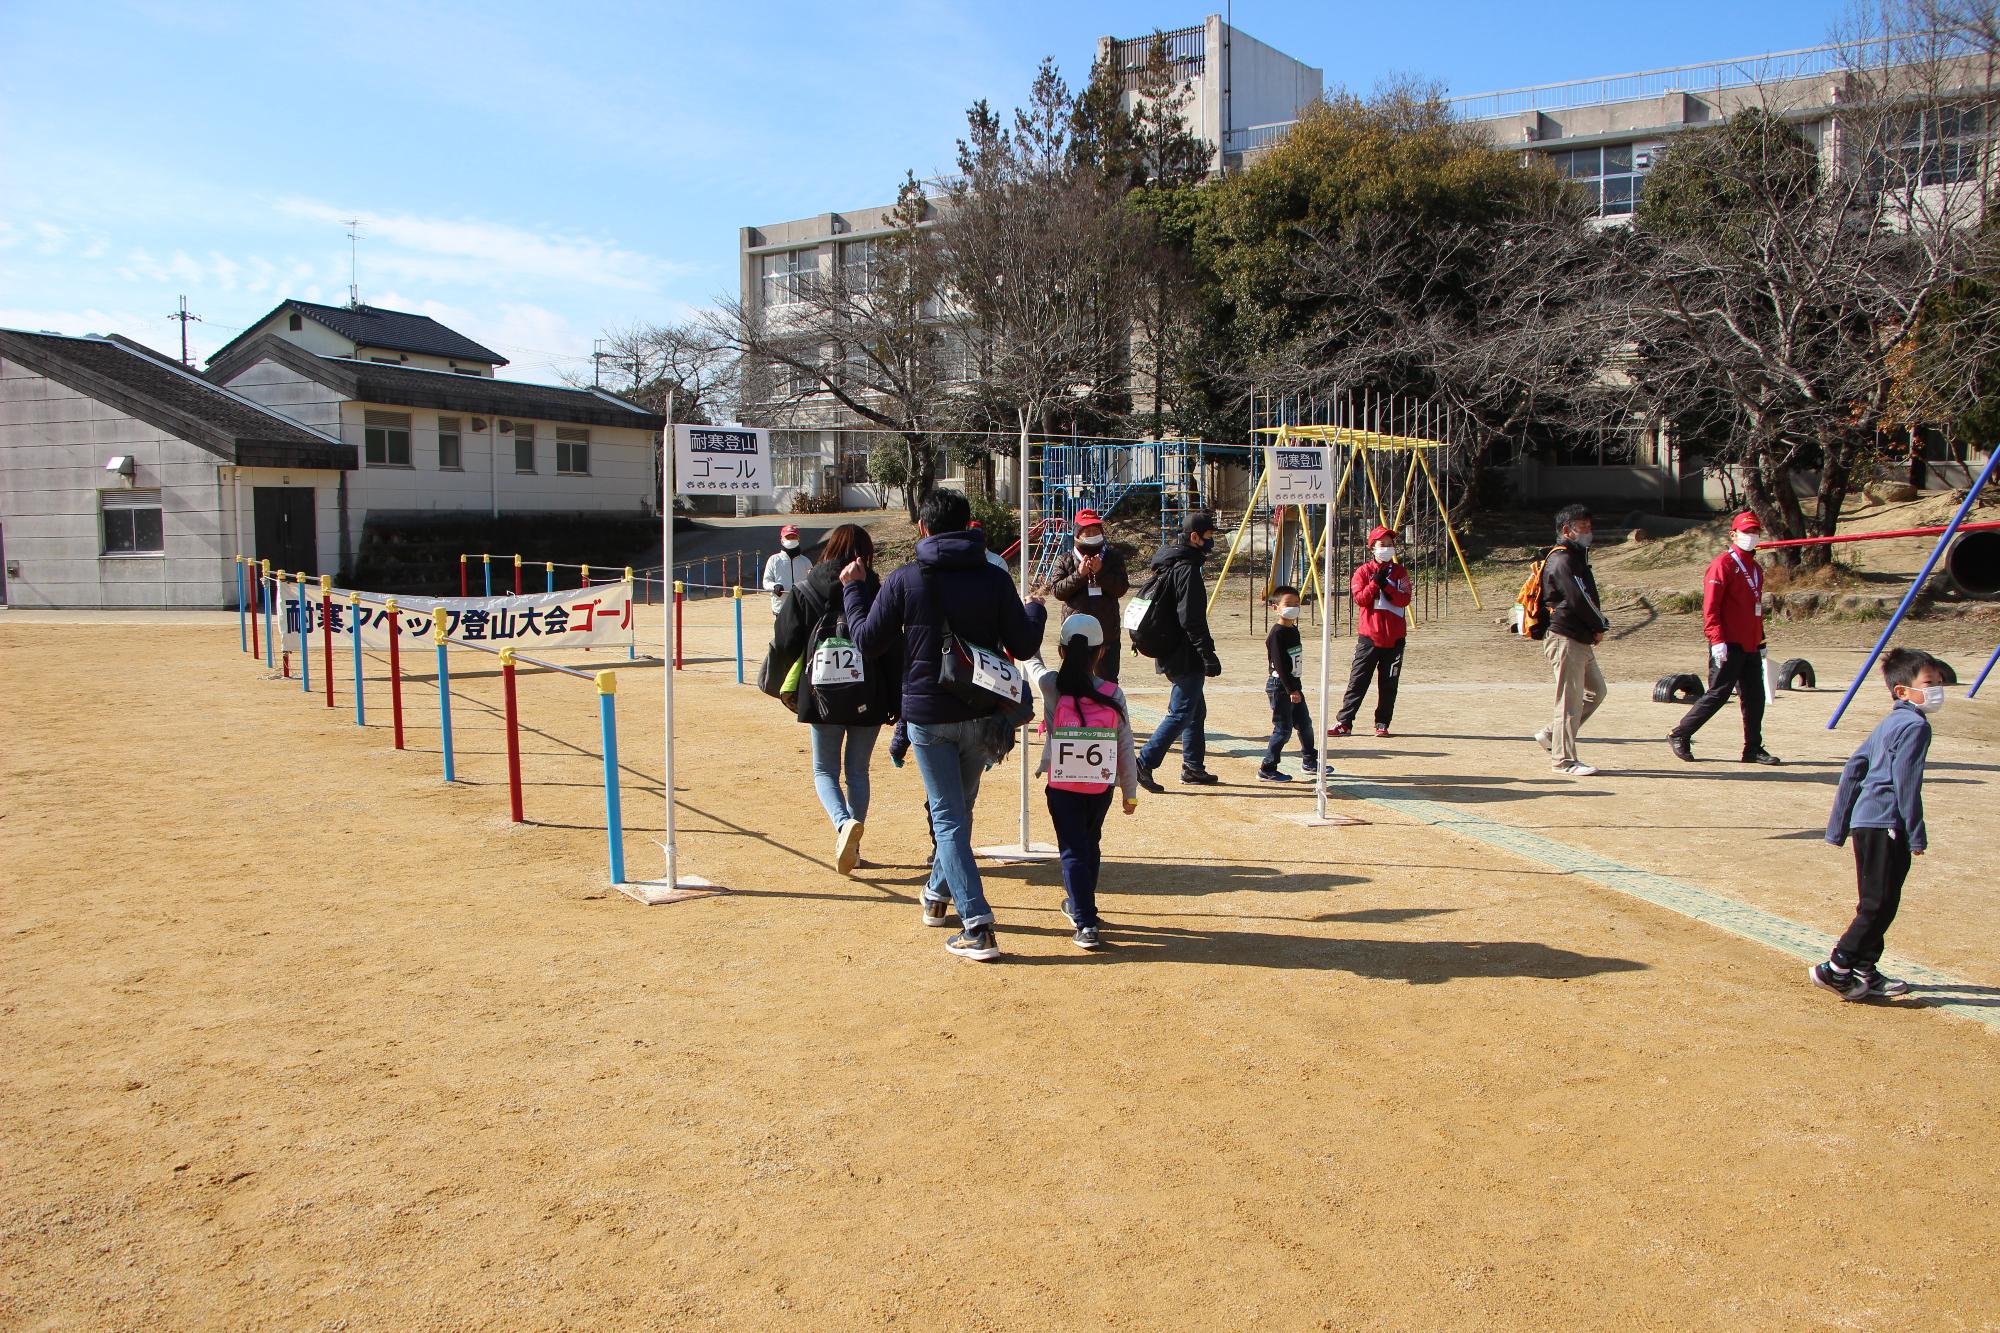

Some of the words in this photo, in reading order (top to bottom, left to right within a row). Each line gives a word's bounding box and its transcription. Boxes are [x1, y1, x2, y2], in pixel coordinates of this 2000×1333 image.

[690, 433, 757, 452] 耐寒登山
[692, 457, 756, 478] ゴール
[1277, 453, 1322, 468] 耐寒登山
[1279, 473, 1322, 490] ゴール
[816, 650, 855, 670] F-12
[978, 652, 1012, 681] F-5
[1060, 743, 1103, 766] F-6
